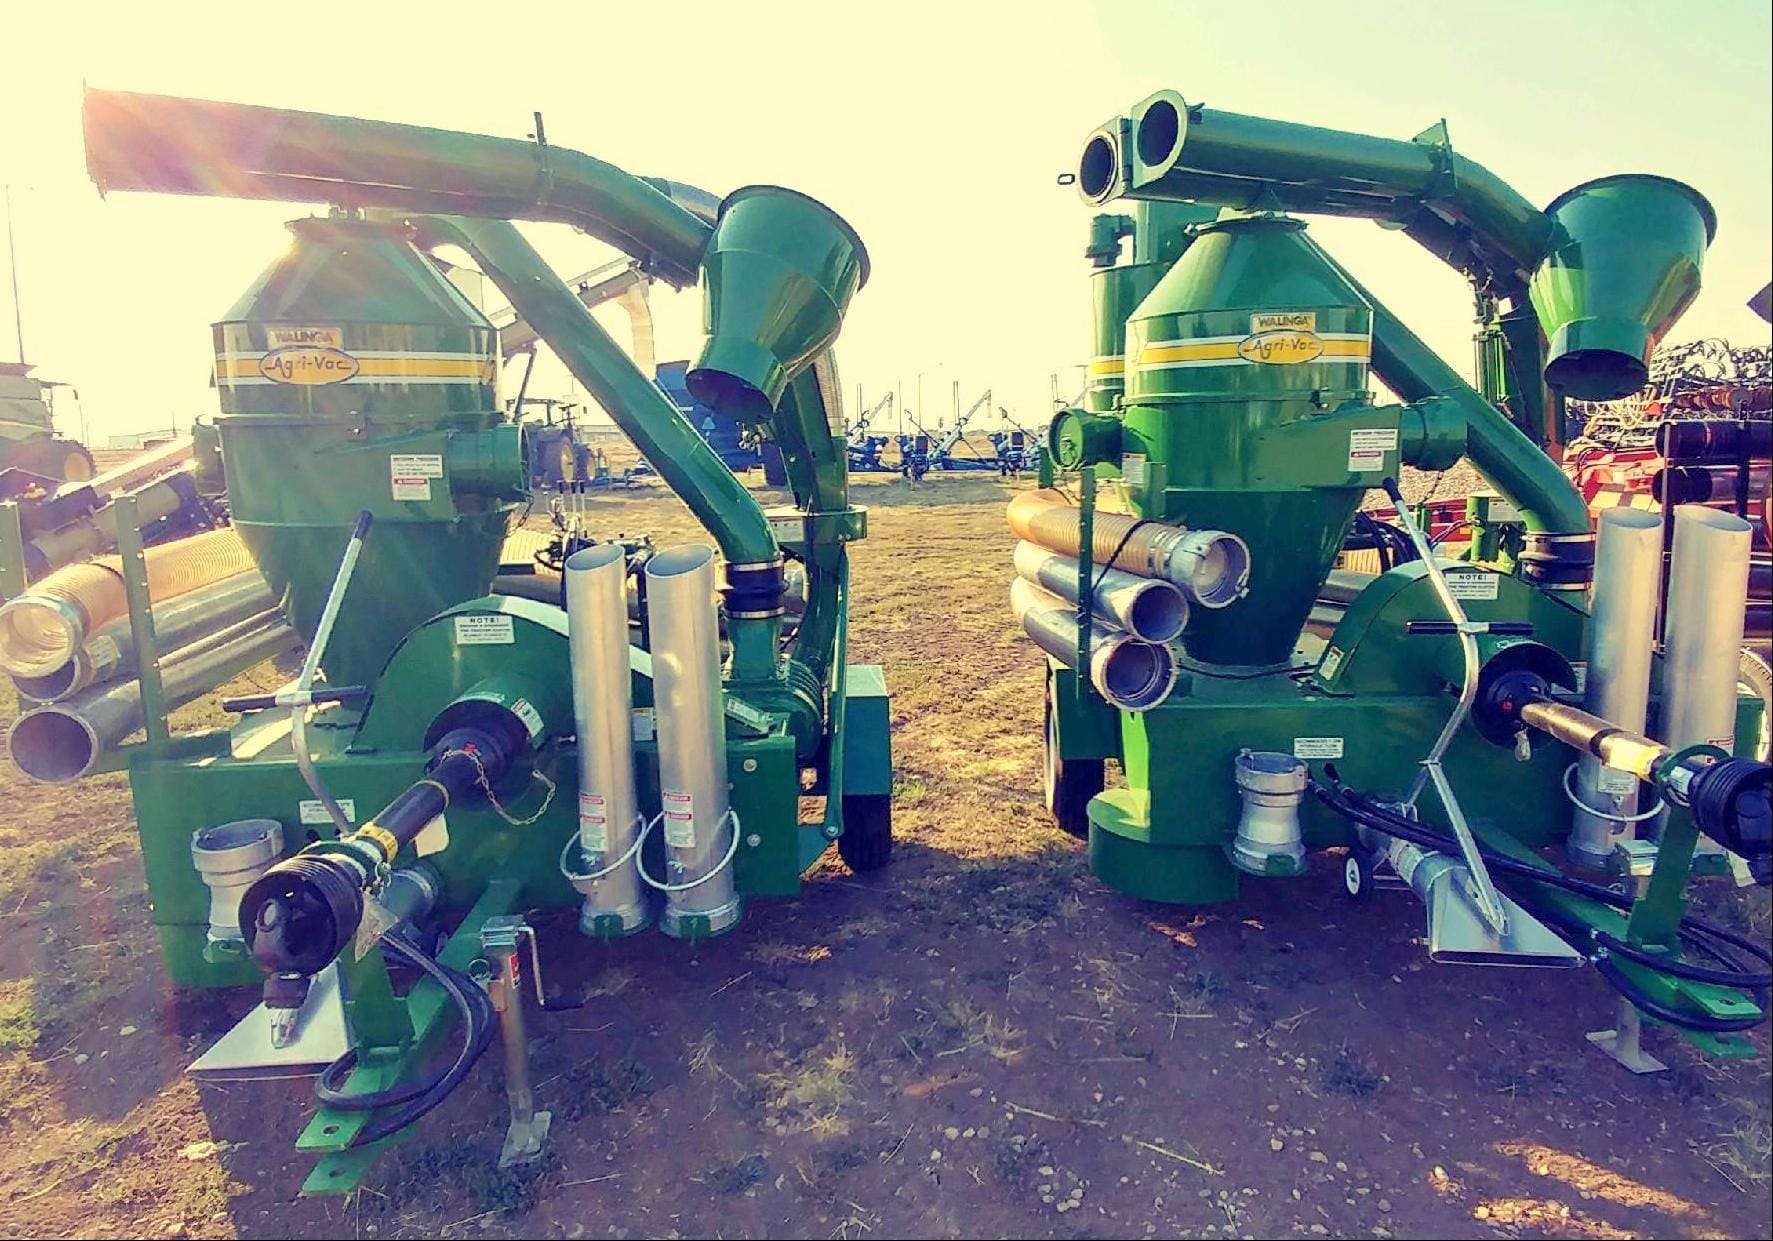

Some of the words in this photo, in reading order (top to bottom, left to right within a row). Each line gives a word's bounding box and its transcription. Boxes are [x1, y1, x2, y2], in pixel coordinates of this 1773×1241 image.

[1258, 315, 1310, 327] WALINGA
[1243, 338, 1320, 360] Agri-Vac
[264, 355, 352, 379] Agri-Vac
